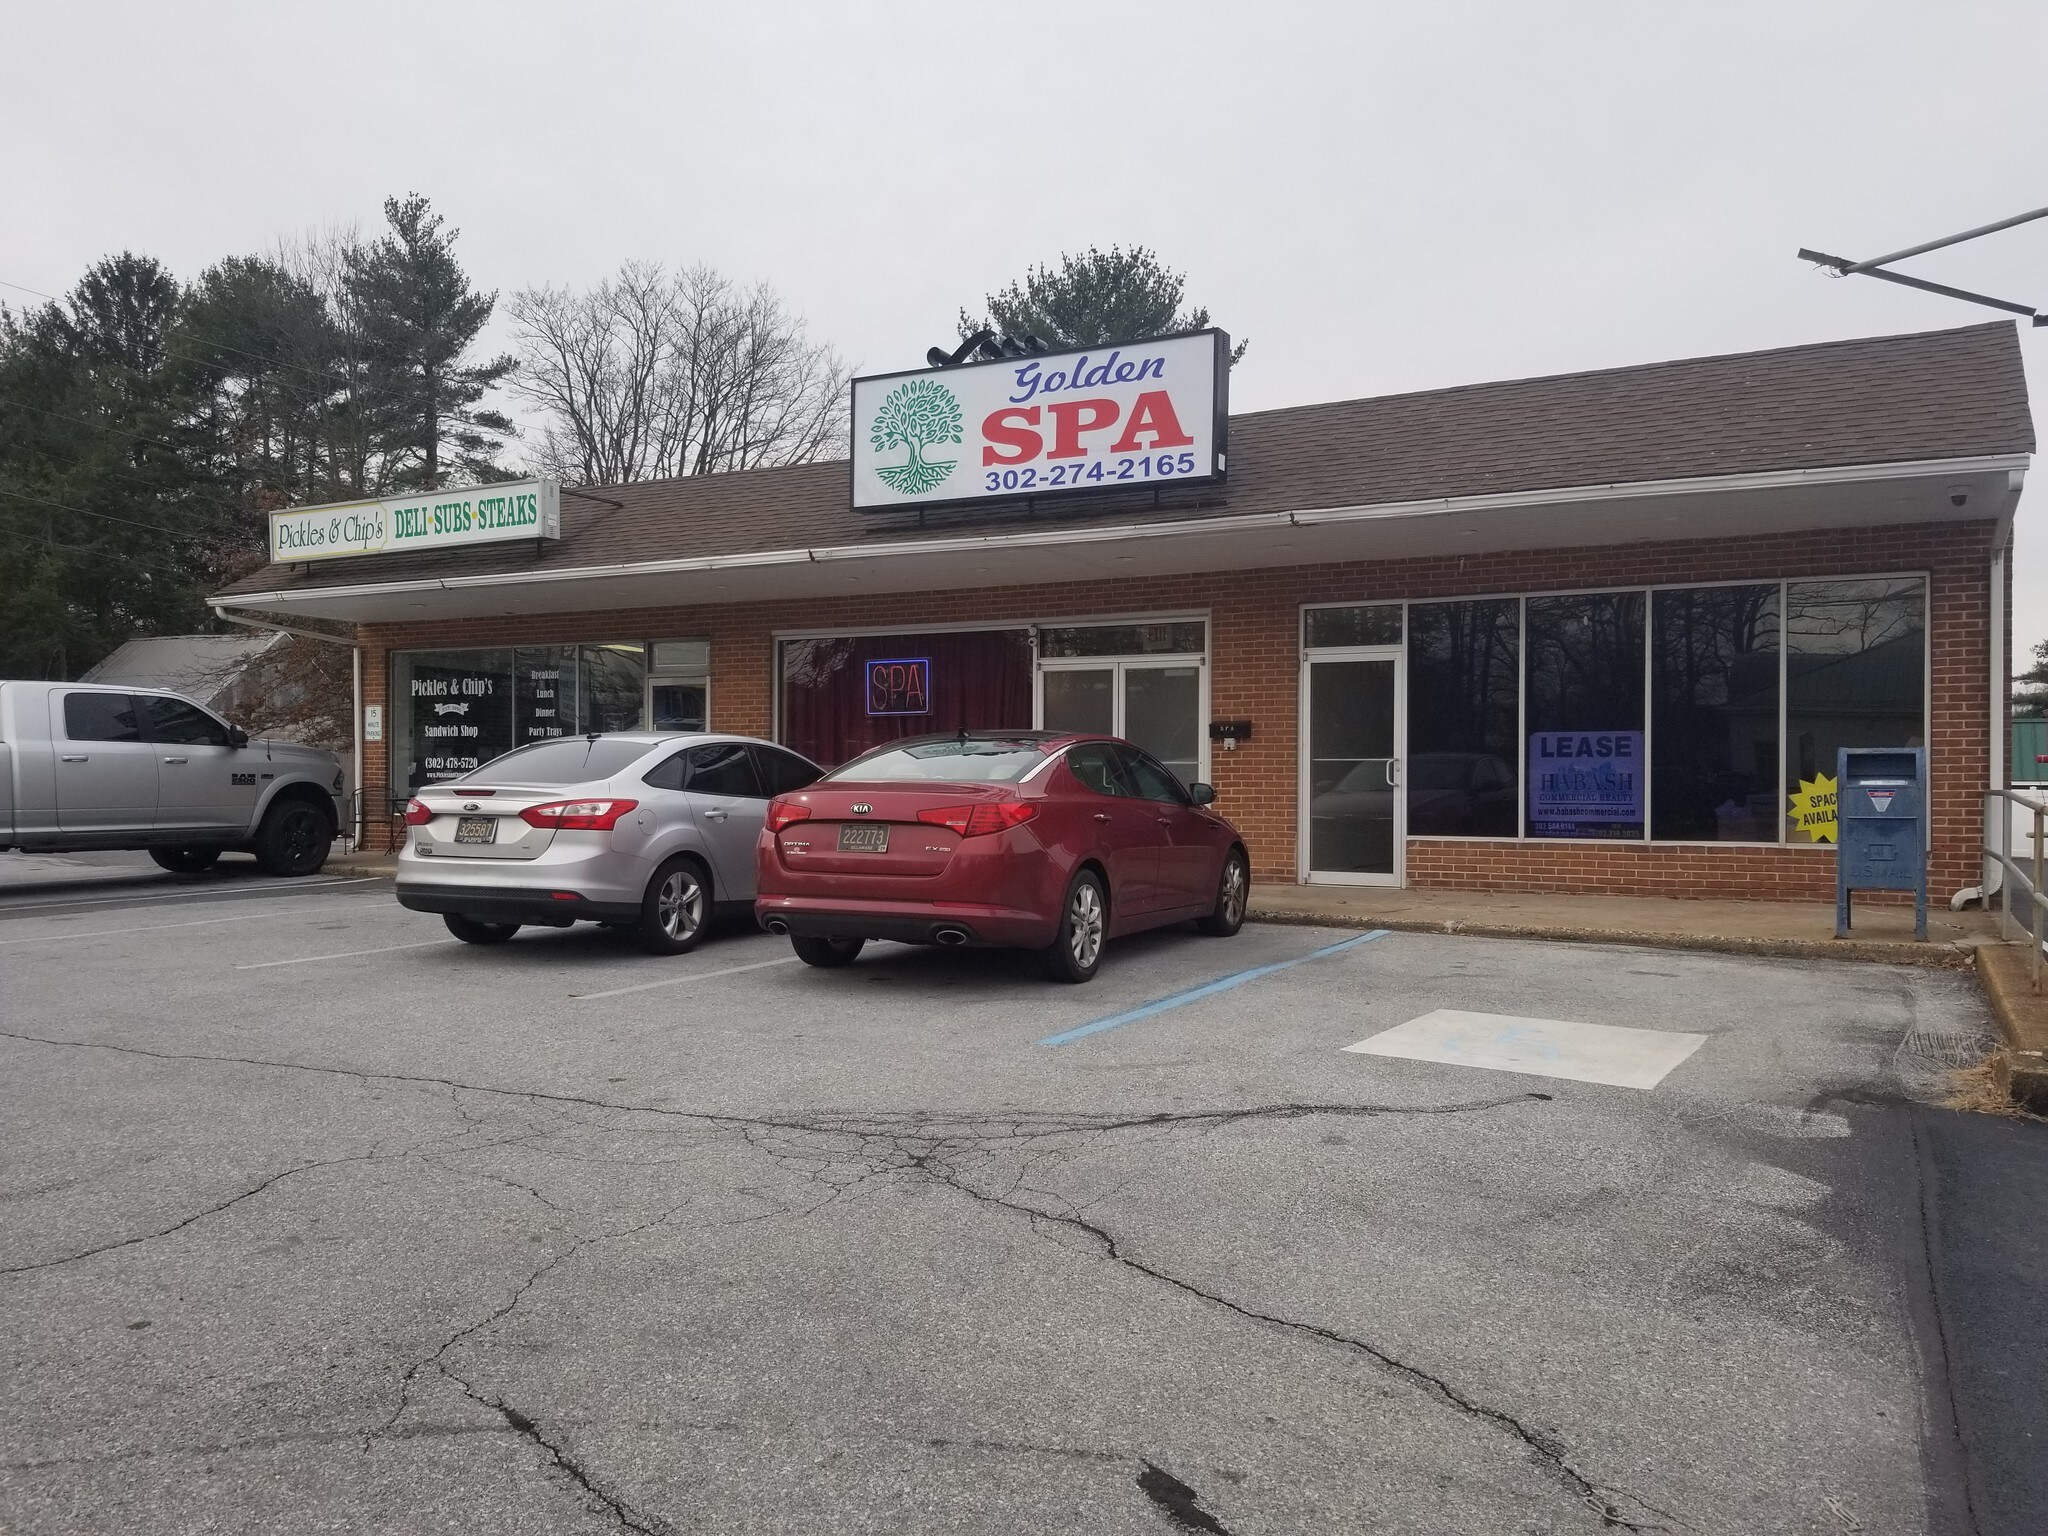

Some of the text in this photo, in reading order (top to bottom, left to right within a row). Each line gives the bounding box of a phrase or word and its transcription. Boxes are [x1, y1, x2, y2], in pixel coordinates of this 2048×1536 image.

[1009, 351, 1166, 404] Golden
[981, 390, 1195, 468] SPA
[985, 452, 1195, 492] 302-274-2165
[394, 493, 537, 539] DELI SUBS STEAKS
[278, 511, 384, 550] Pickles & Chip's
[531, 670, 560, 680] Breakfast
[411, 677, 493, 697] Pickles & Chip's
[536, 688, 554, 698] Lunch
[872, 664, 923, 710] SPA
[370, 709, 377, 718] 15
[535, 707, 555, 717] Dinner
[424, 725, 479, 738] Sandwich Shop
[528, 726, 563, 737] Party Trays
[1540, 735, 1632, 758] LEASE
[425, 757, 478, 769] (302) 478-5720
[1541, 772, 1633, 792] HABASH
[1539, 793, 1634, 802] COMMERCIAL REALTY
[1809, 792, 1837, 808] SPAC
[853, 805, 869, 813] KIA
[1537, 807, 1636, 817] www.habashcommercial.com
[459, 823, 492, 837] 325587
[842, 829, 884, 845] 222773
